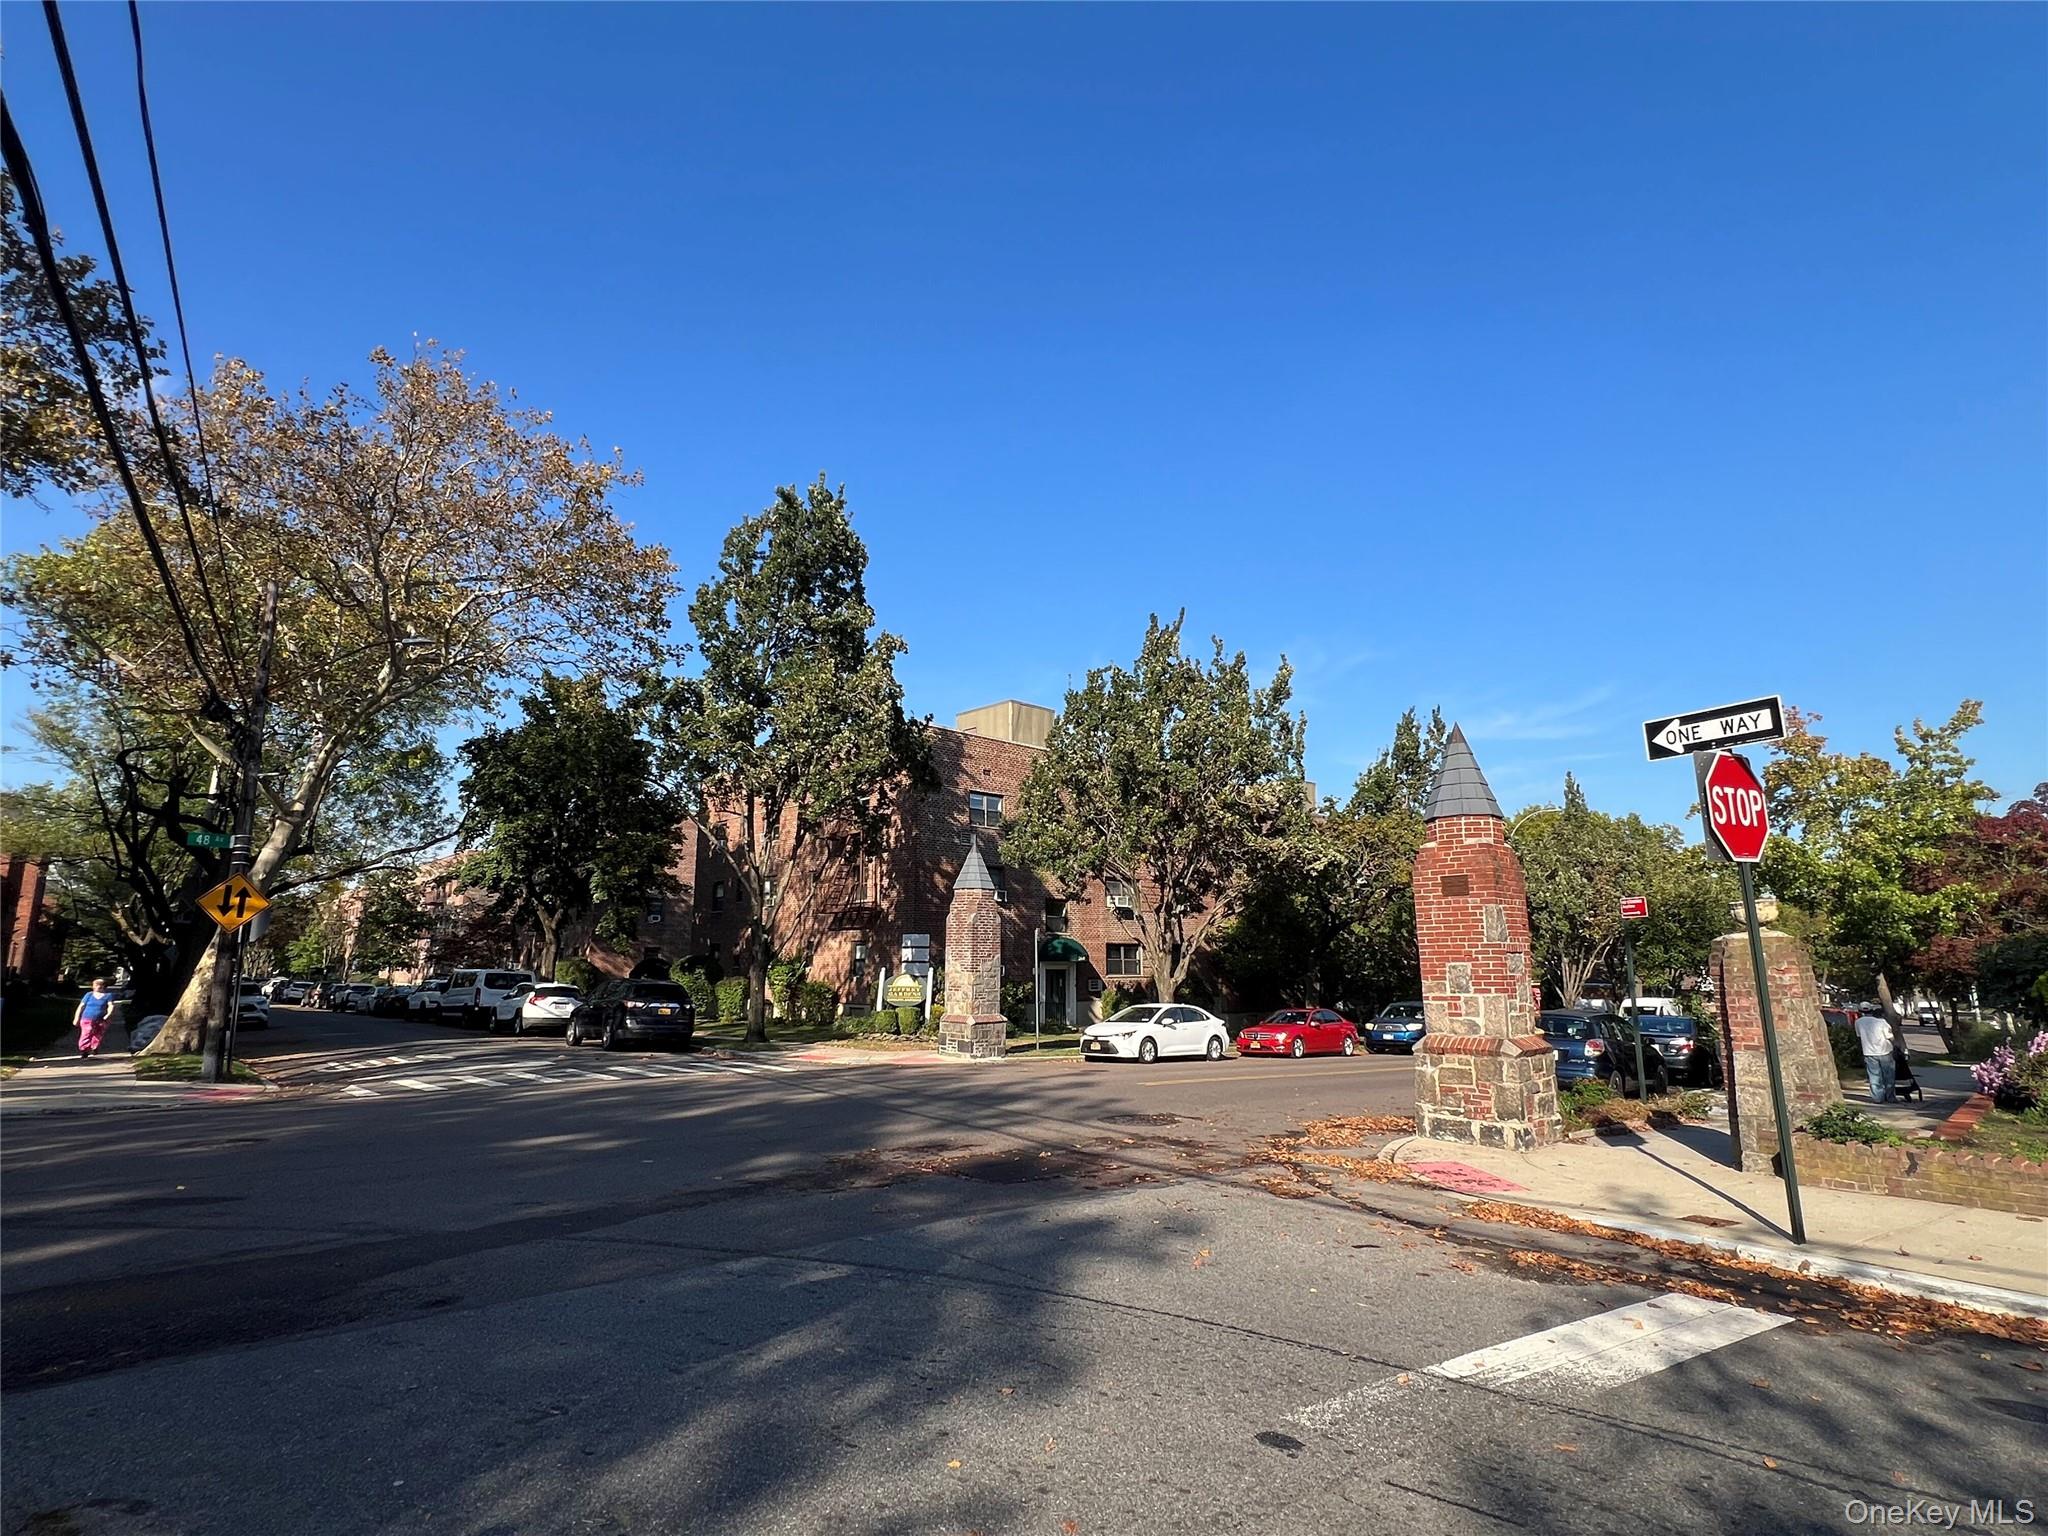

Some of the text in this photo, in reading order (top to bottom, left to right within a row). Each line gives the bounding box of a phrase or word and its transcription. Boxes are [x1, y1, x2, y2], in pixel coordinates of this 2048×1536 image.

[1666, 713, 1761, 745] ONE WAY
[1711, 784, 1762, 827] STOP
[196, 834, 210, 845] 48
